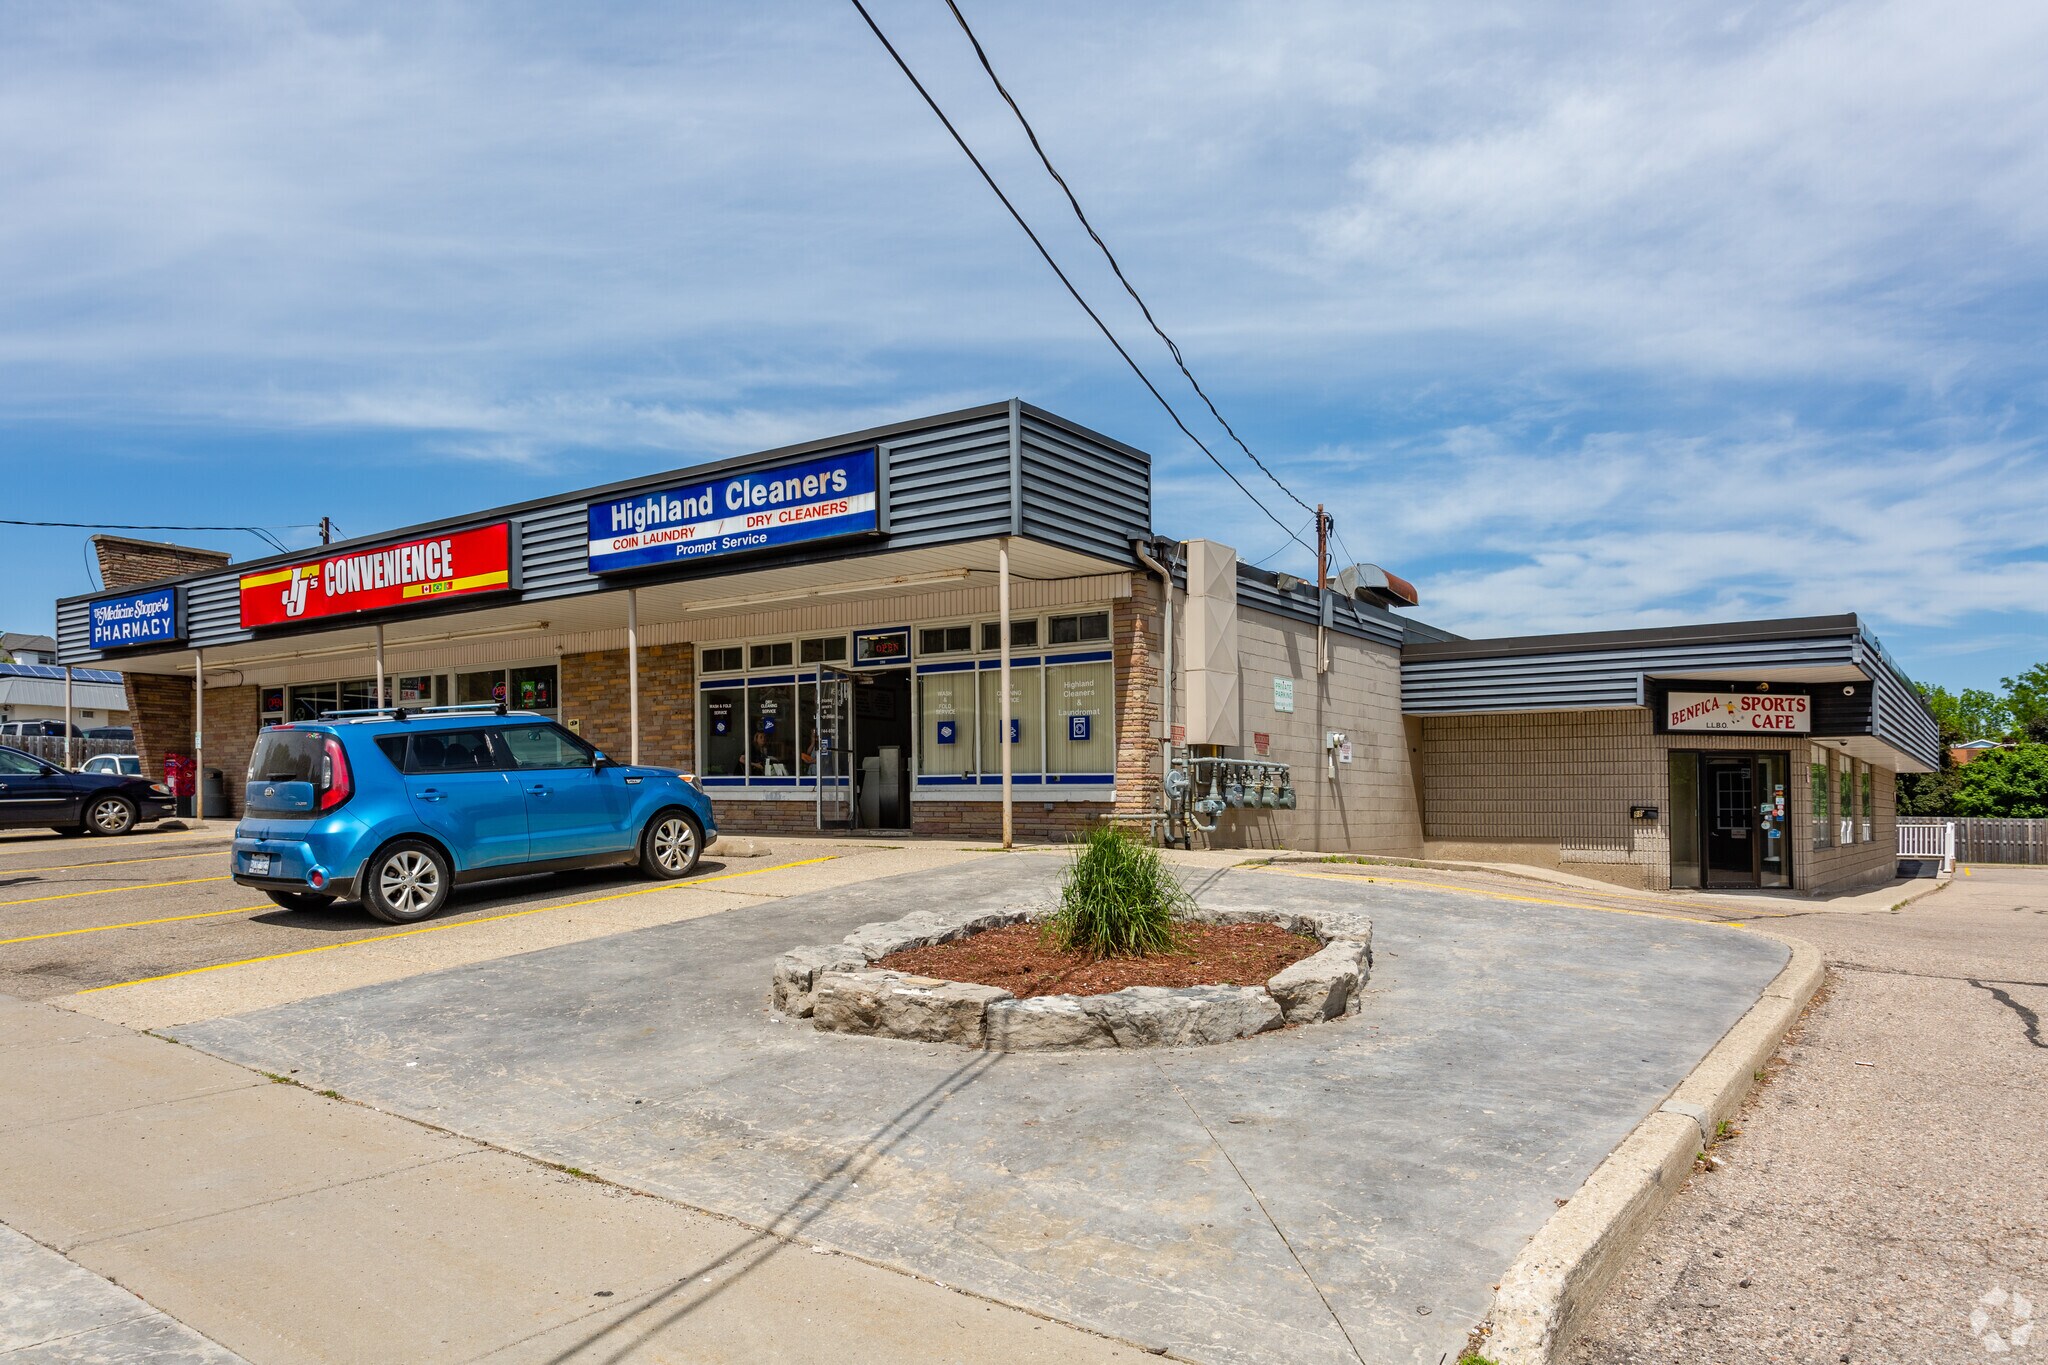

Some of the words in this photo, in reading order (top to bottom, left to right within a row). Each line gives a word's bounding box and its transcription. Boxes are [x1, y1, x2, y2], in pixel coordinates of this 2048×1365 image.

[611, 486, 713, 533] Highland
[725, 468, 848, 512] Cleaners
[613, 536, 639, 551] COIN
[643, 526, 696, 545] LAUNDRY
[746, 513, 773, 529] DRY
[778, 501, 848, 523] CLEANERS
[676, 539, 717, 557] Prompt
[722, 532, 768, 550] Service
[324, 539, 453, 597] CONVENIENCE
[98, 603, 134, 626] Medicine
[95, 618, 171, 643] PHARMACY
[876, 643, 899, 653] OPEN
[1063, 690, 1095, 699] Cleaners
[1064, 680, 1094, 690] Highland
[1276, 682, 1292, 690] PRIVATE
[1276, 690, 1293, 699] PARKING
[1058, 708, 1101, 716] Laundromat
[1671, 696, 1720, 726] BENFICA
[1740, 696, 1807, 712] SPORTS
[1751, 714, 1796, 729] CAFE
